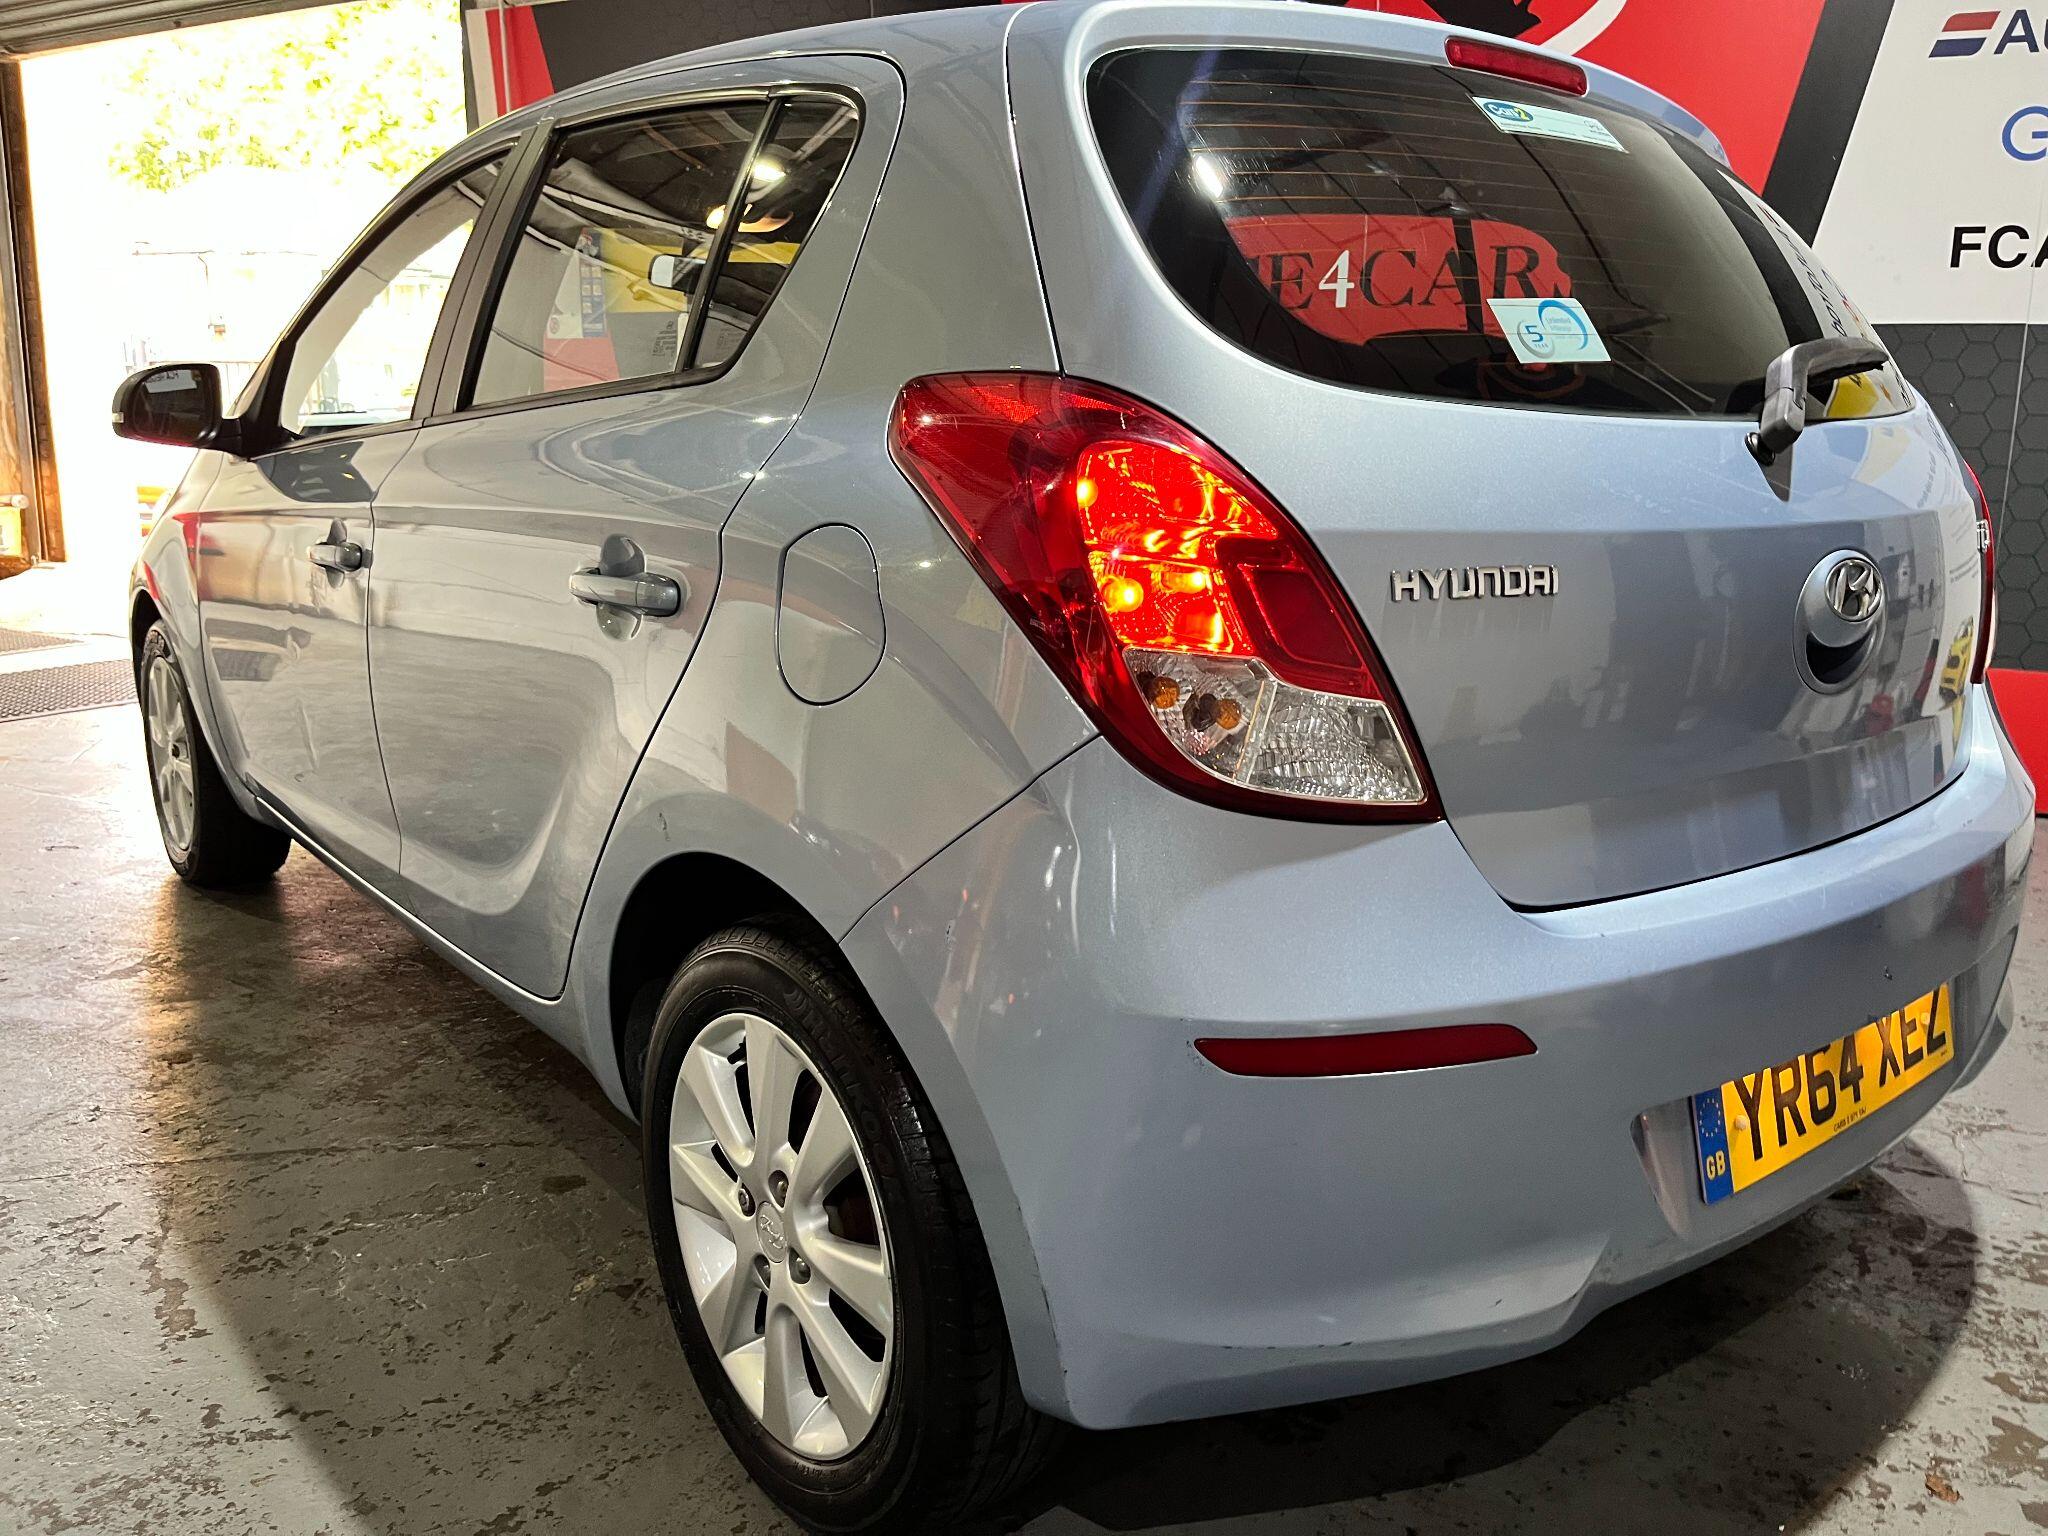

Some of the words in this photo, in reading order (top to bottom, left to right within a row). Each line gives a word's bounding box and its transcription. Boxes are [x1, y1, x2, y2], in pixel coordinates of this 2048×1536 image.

[1525, 325, 1544, 342] 5
[1391, 564, 1559, 601] HYUNDAI
[1733, 1033, 1864, 1162] YR64
[1875, 987, 1947, 1088] XEZ
[1706, 1150, 1726, 1181] GB
